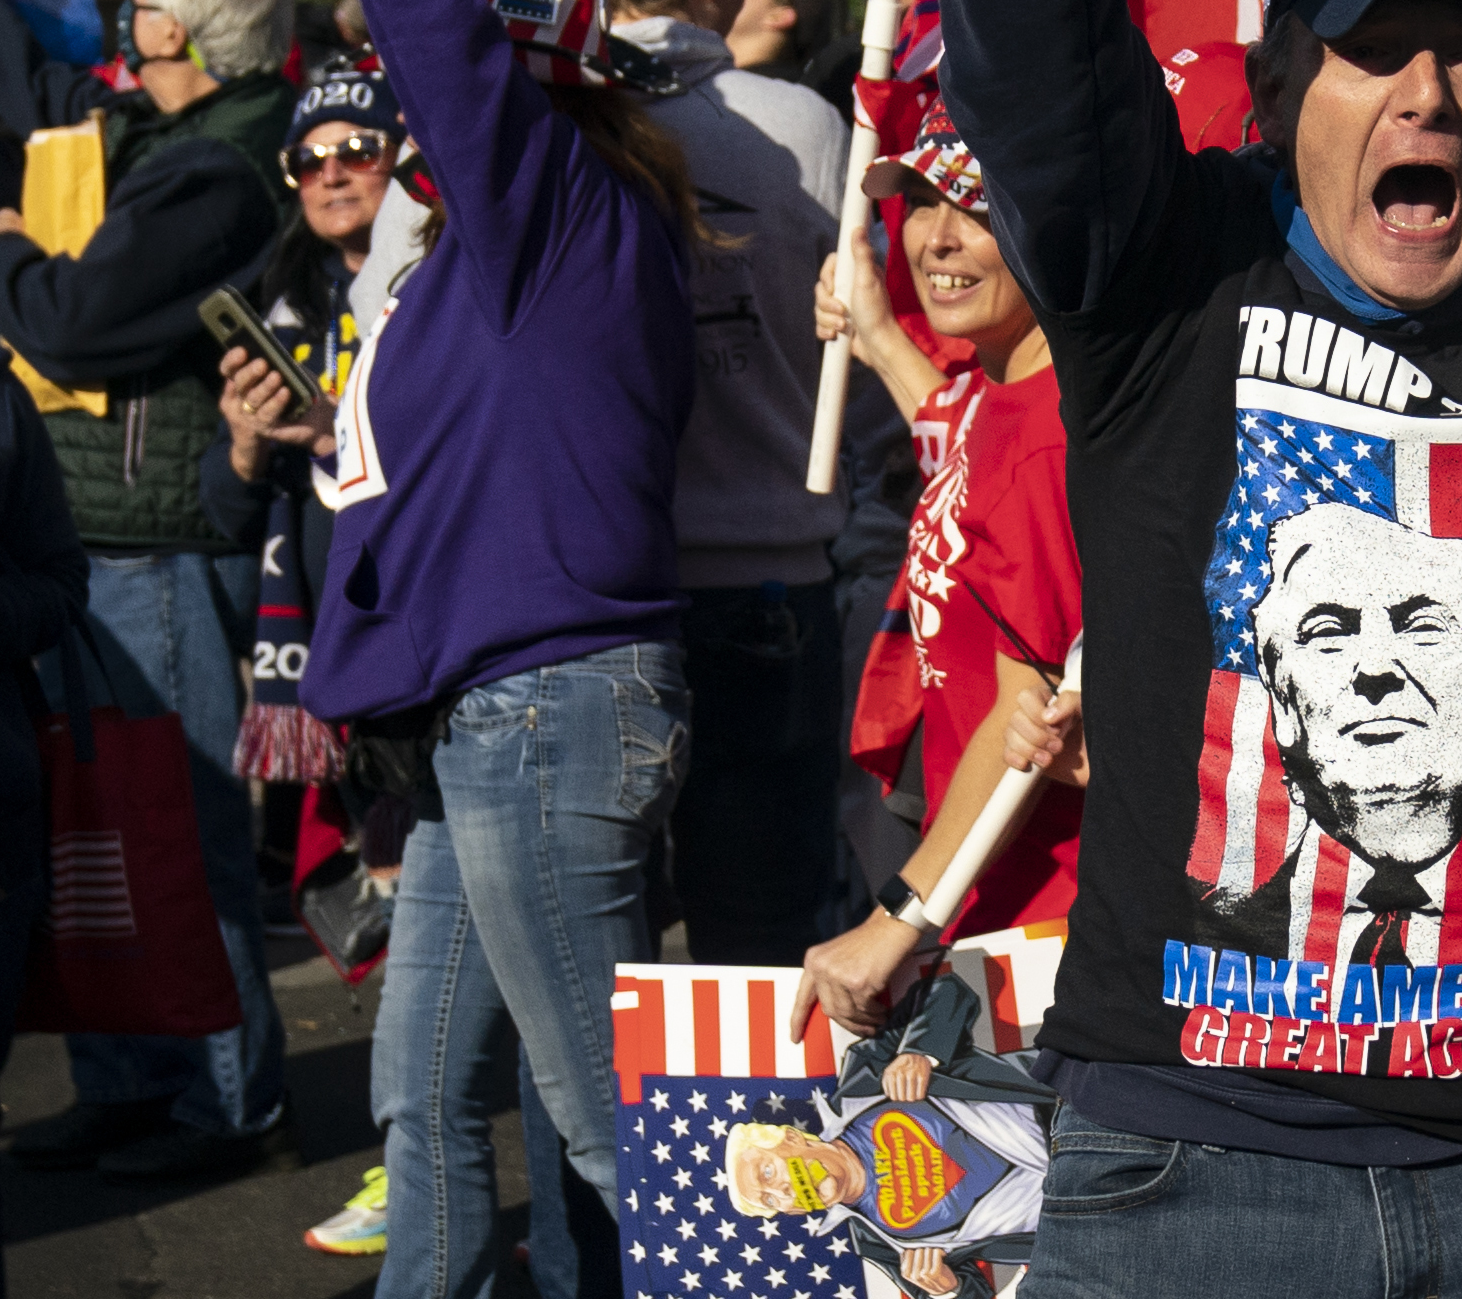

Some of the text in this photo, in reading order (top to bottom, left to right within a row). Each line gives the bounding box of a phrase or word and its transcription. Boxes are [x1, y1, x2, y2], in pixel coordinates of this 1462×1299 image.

[253, 640, 310, 680] 20
[1163, 939, 1333, 1024] MAKE
[1180, 1003, 1380, 1075] GREAT
[874, 1149, 896, 1205] MAKE
[890, 1126, 917, 1220] President
